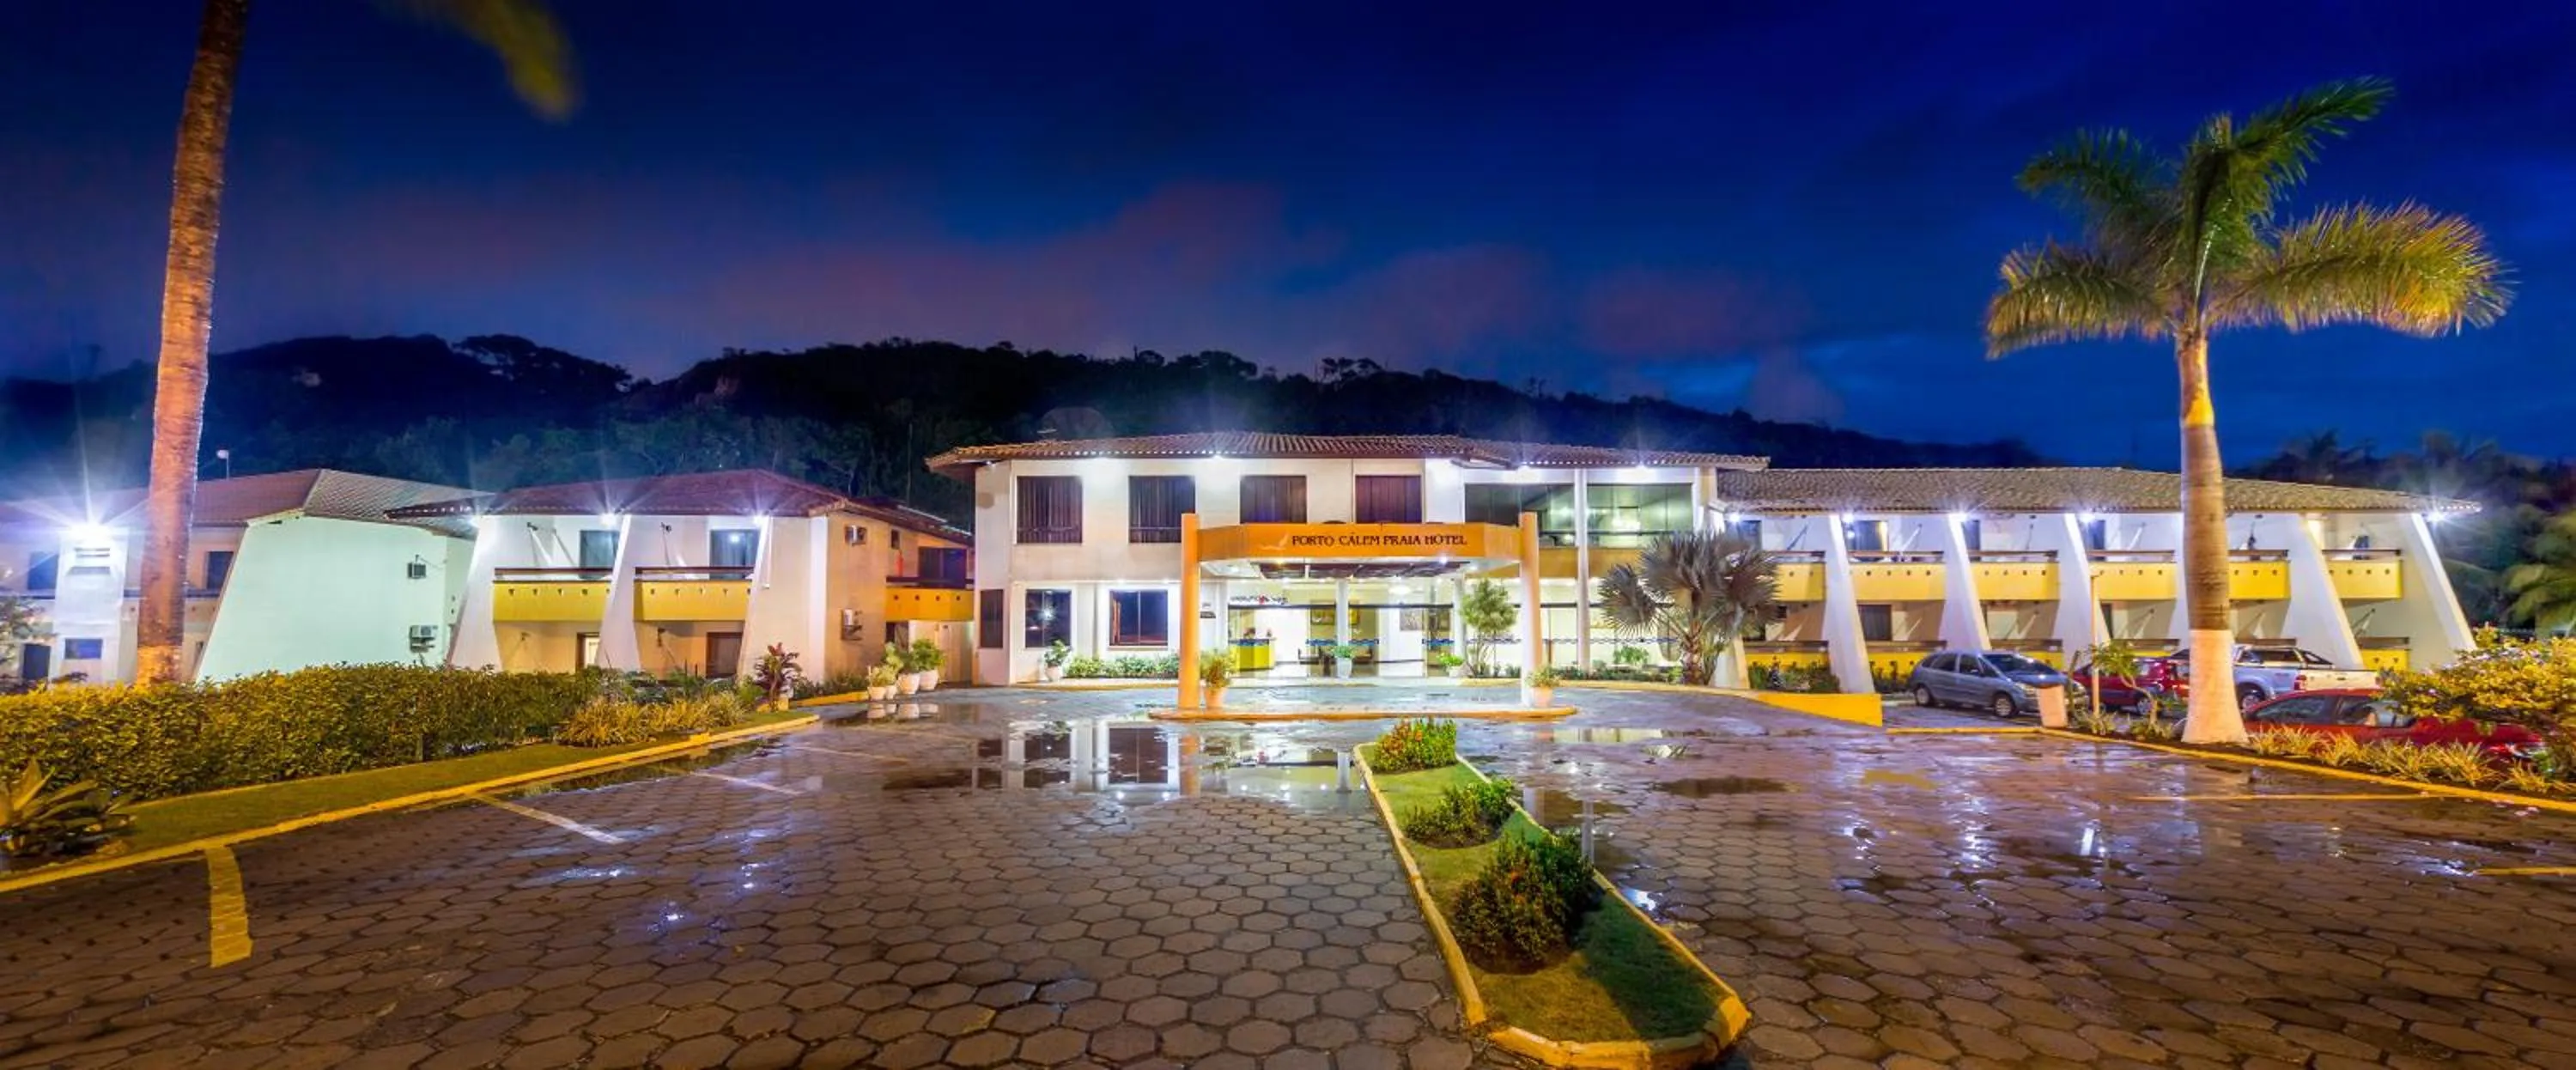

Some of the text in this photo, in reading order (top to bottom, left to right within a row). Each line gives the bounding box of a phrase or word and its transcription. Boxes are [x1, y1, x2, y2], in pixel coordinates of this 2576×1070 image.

[1291, 532, 1467, 546] PORTO CÁLEM PRAIA HOTEL
